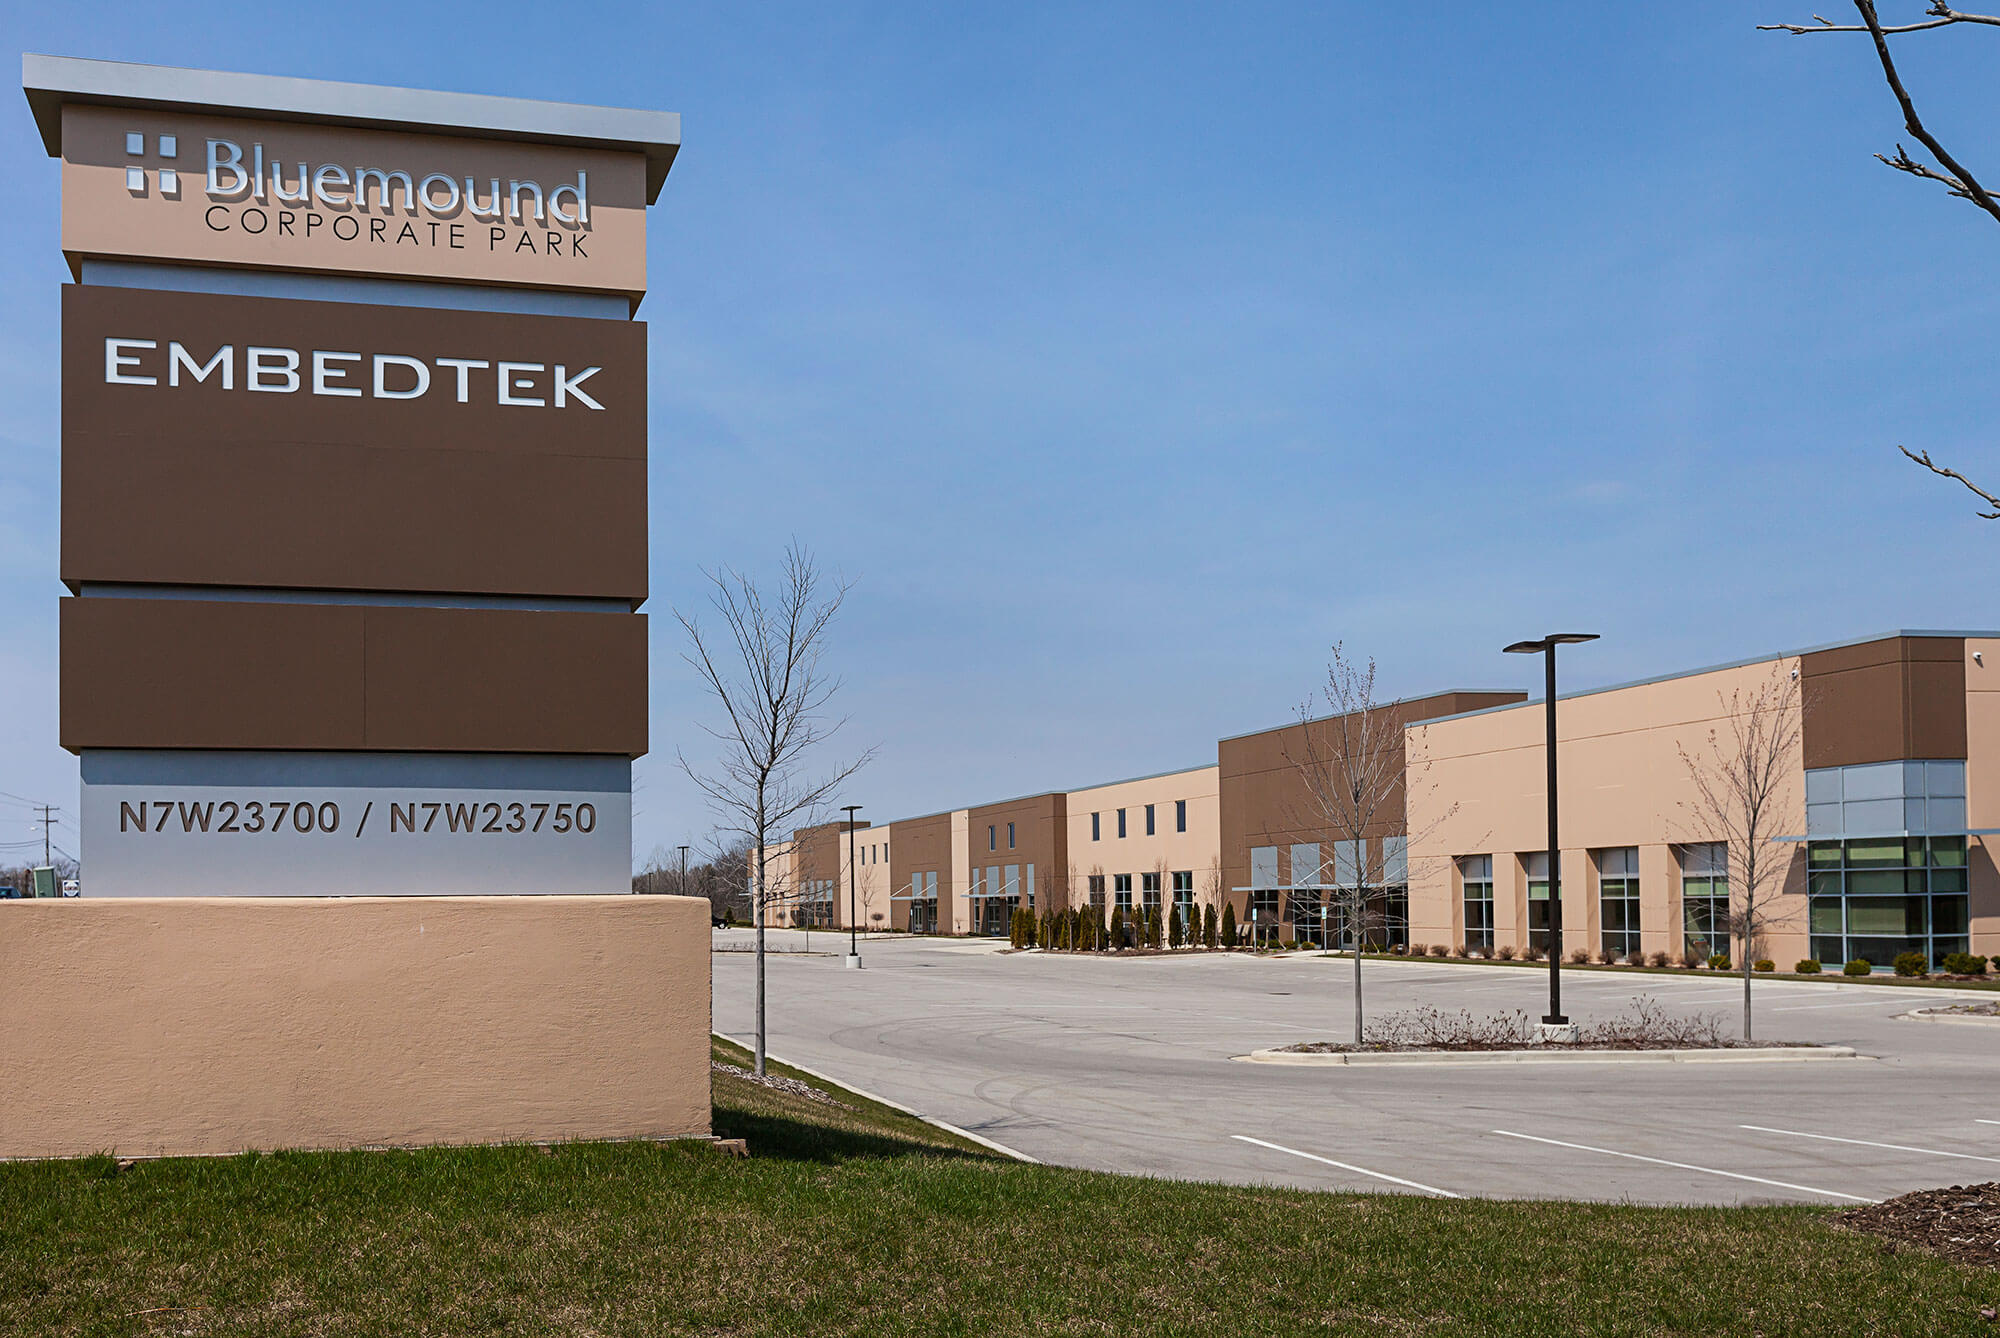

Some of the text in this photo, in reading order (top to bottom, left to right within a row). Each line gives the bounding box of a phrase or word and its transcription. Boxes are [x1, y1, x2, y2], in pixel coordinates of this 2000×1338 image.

[204, 137, 589, 224] Bluemound
[205, 205, 589, 258] CORPORATE PARK
[104, 337, 606, 411] EMBEDTEK
[119, 800, 597, 839] N7W23700 / N7W23750
